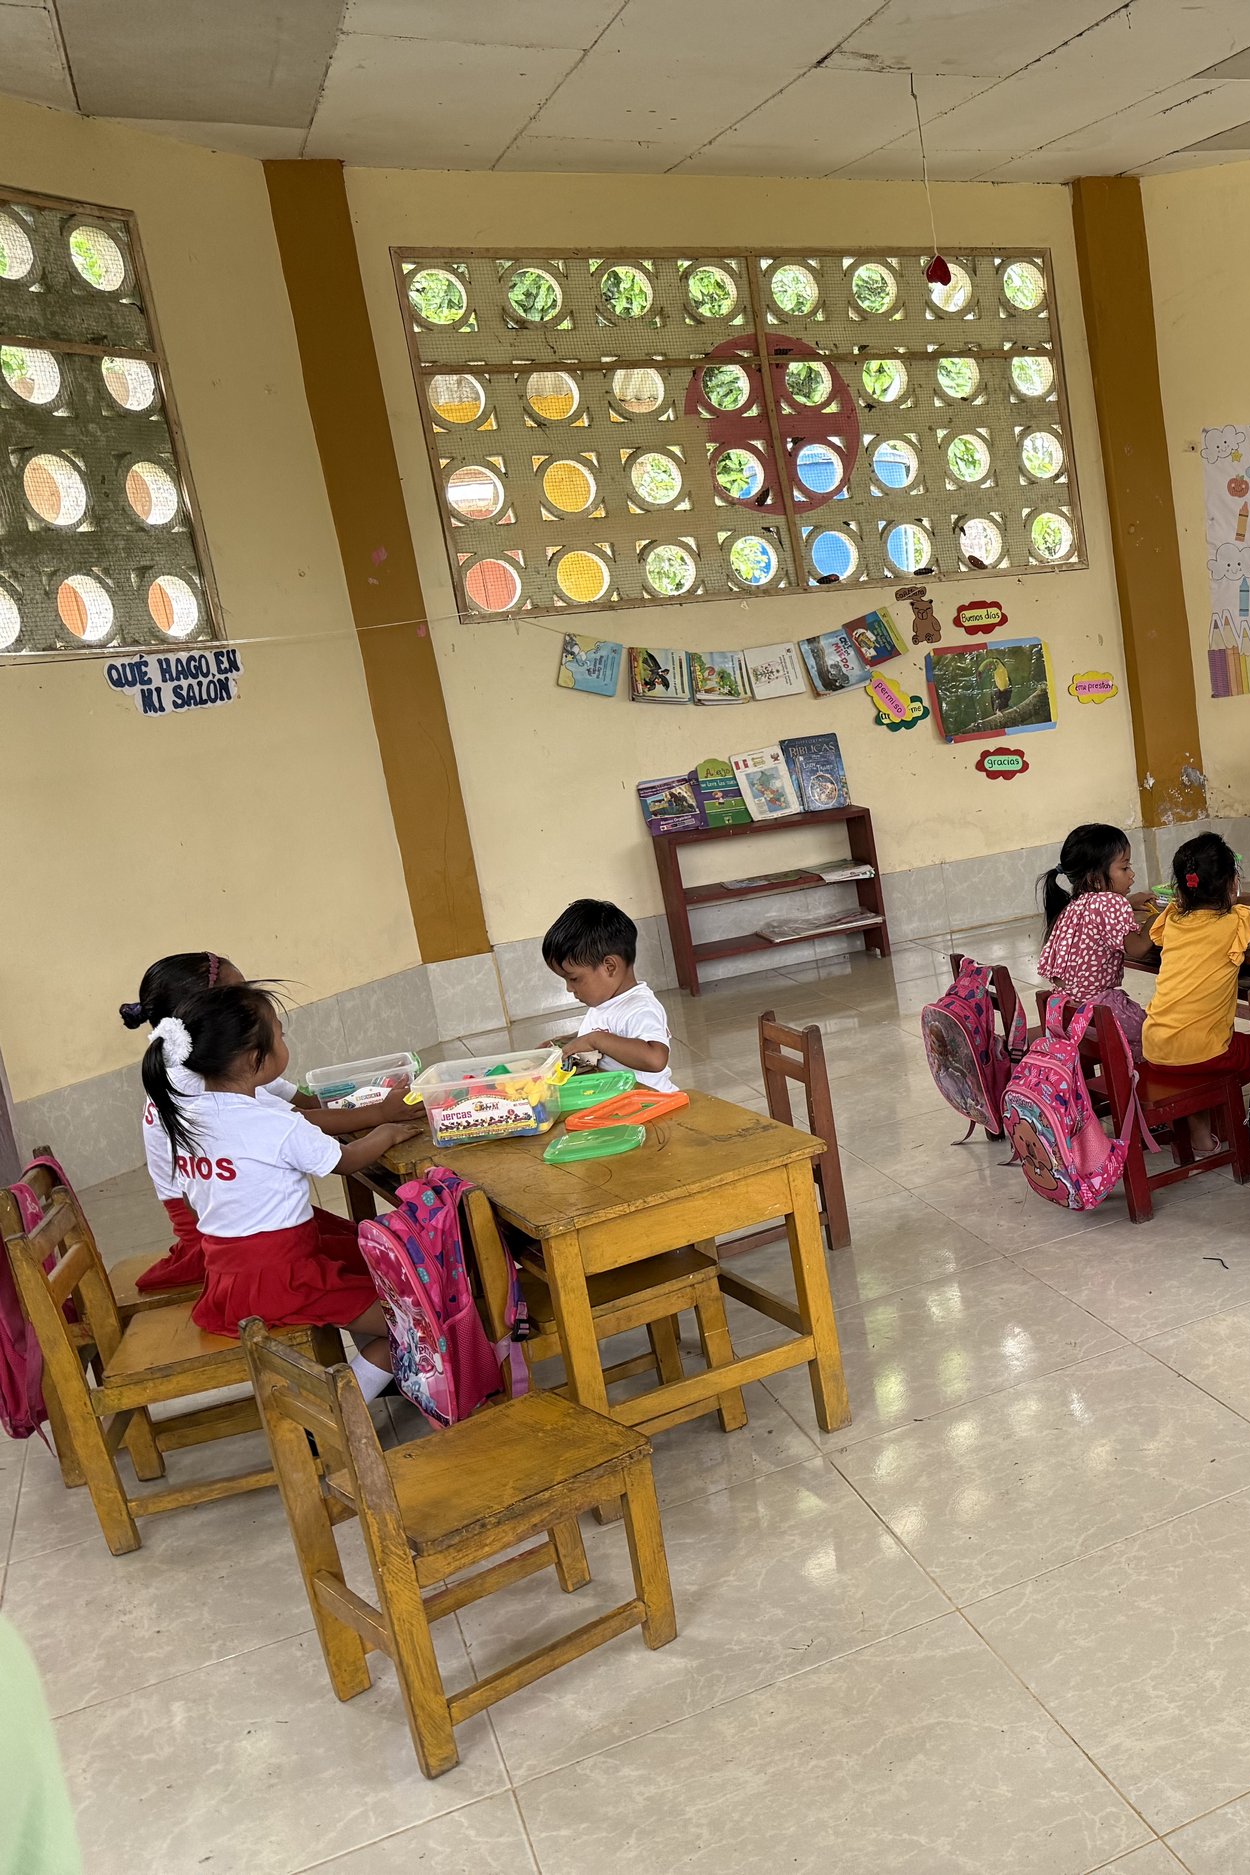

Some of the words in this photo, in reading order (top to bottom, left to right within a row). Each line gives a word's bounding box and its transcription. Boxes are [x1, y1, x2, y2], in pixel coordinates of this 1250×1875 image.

[961, 612, 983, 623] Buenos
[984, 609, 1001, 620] días
[106, 653, 152, 689] QUÉ
[156, 653, 211, 683] HAGO
[213, 648, 241, 675] EN
[140, 686, 166, 714] MI
[171, 672, 232, 710] SALÓN
[874, 682, 904, 714] permiso
[986, 756, 1020, 769] gracias
[176, 1155, 237, 1182] RIOS
